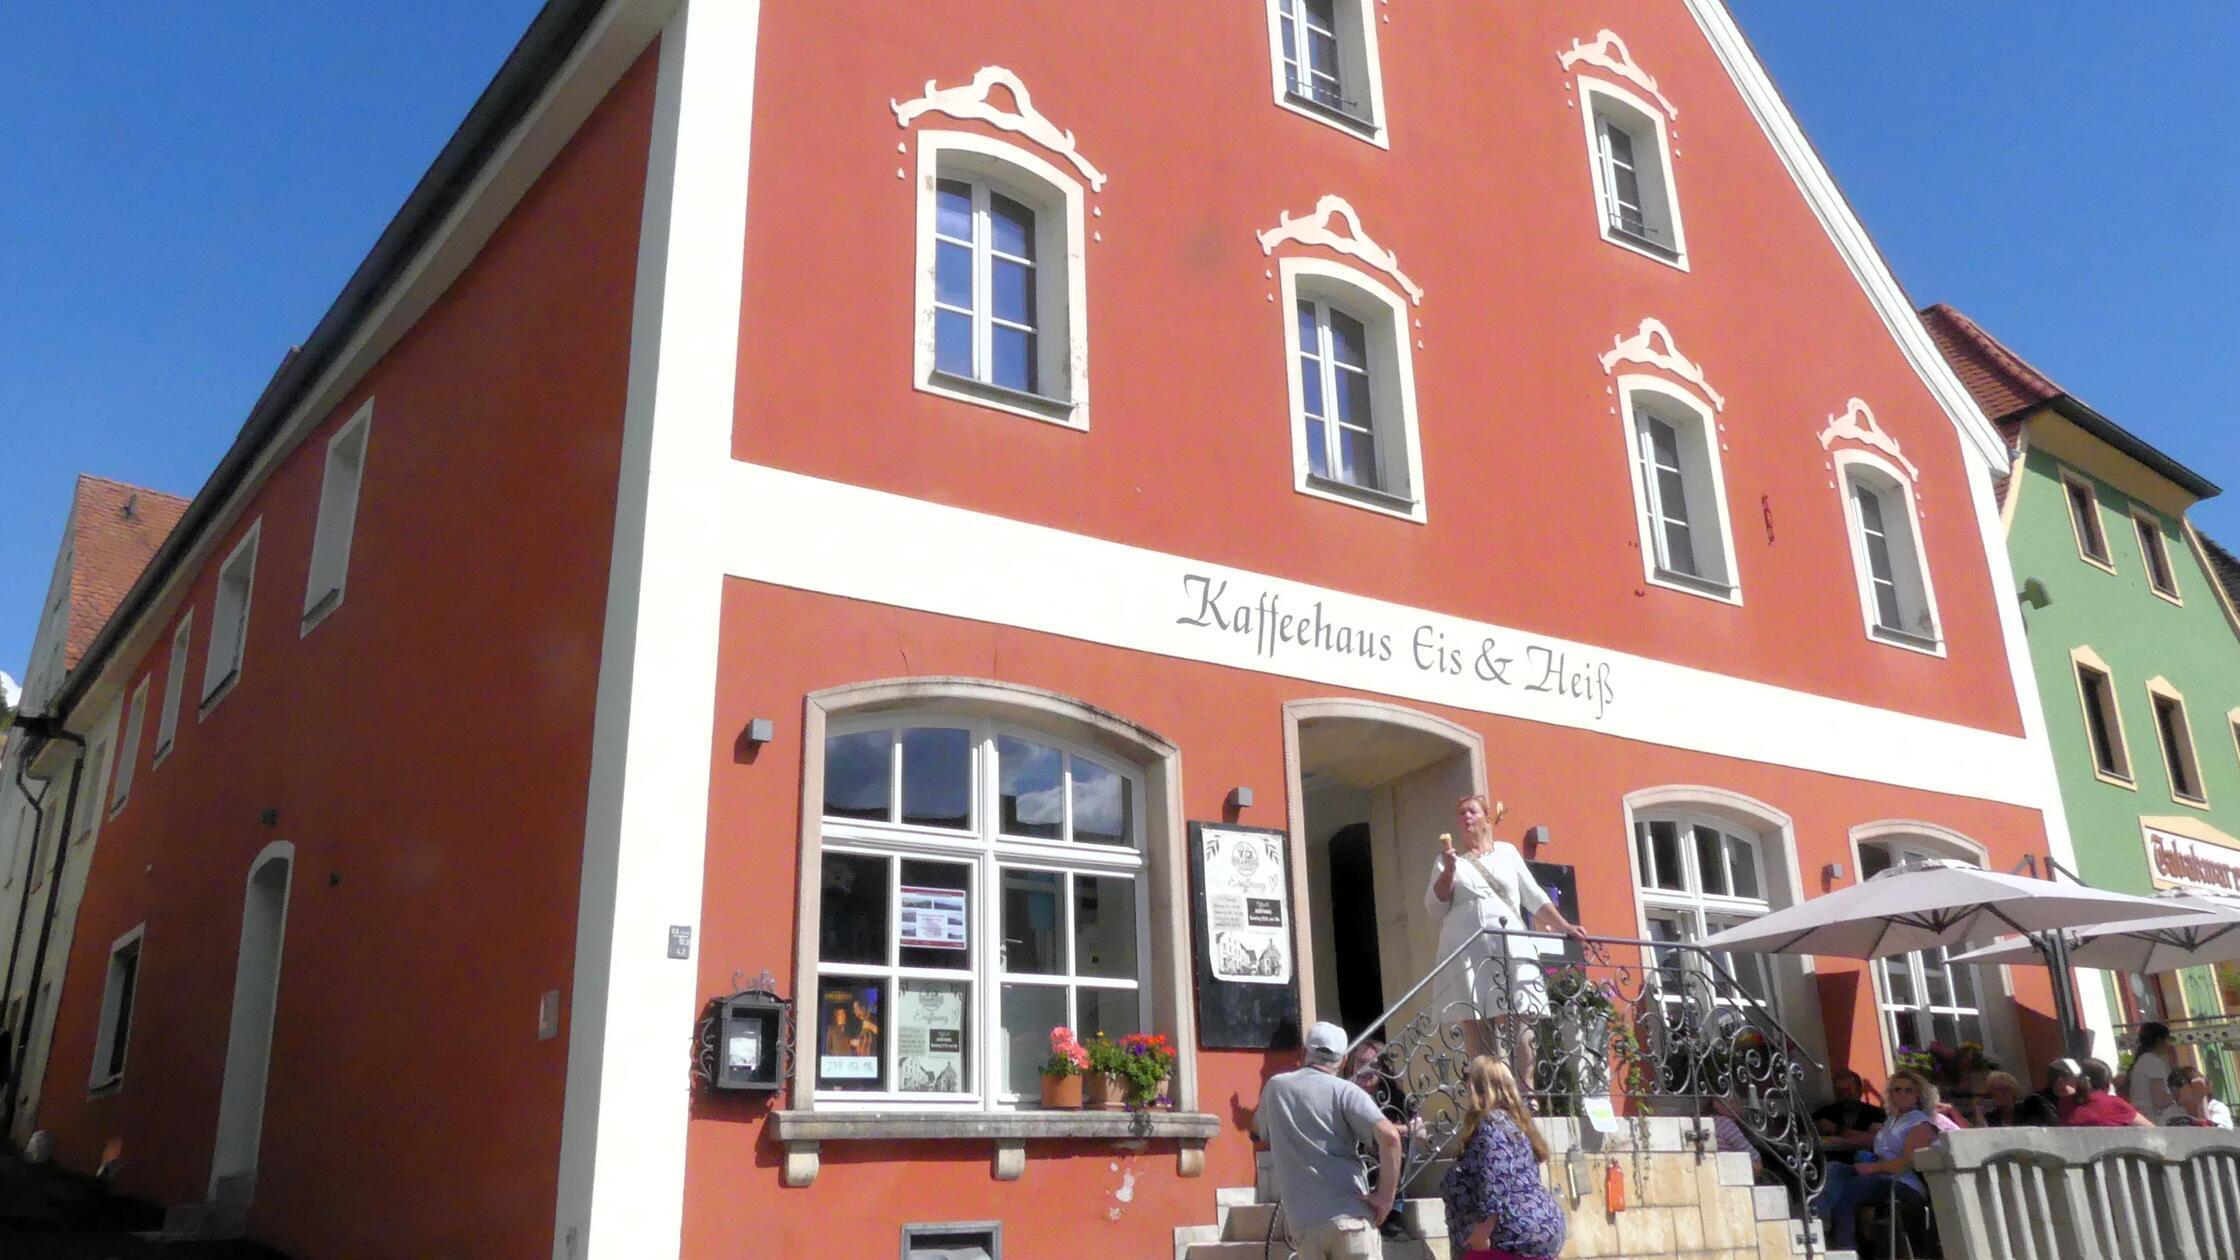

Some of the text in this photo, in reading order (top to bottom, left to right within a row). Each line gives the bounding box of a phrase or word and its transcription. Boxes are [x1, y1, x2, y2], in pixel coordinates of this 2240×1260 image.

[1175, 573, 1614, 721] Kaffeehaus Eis & Heiß
